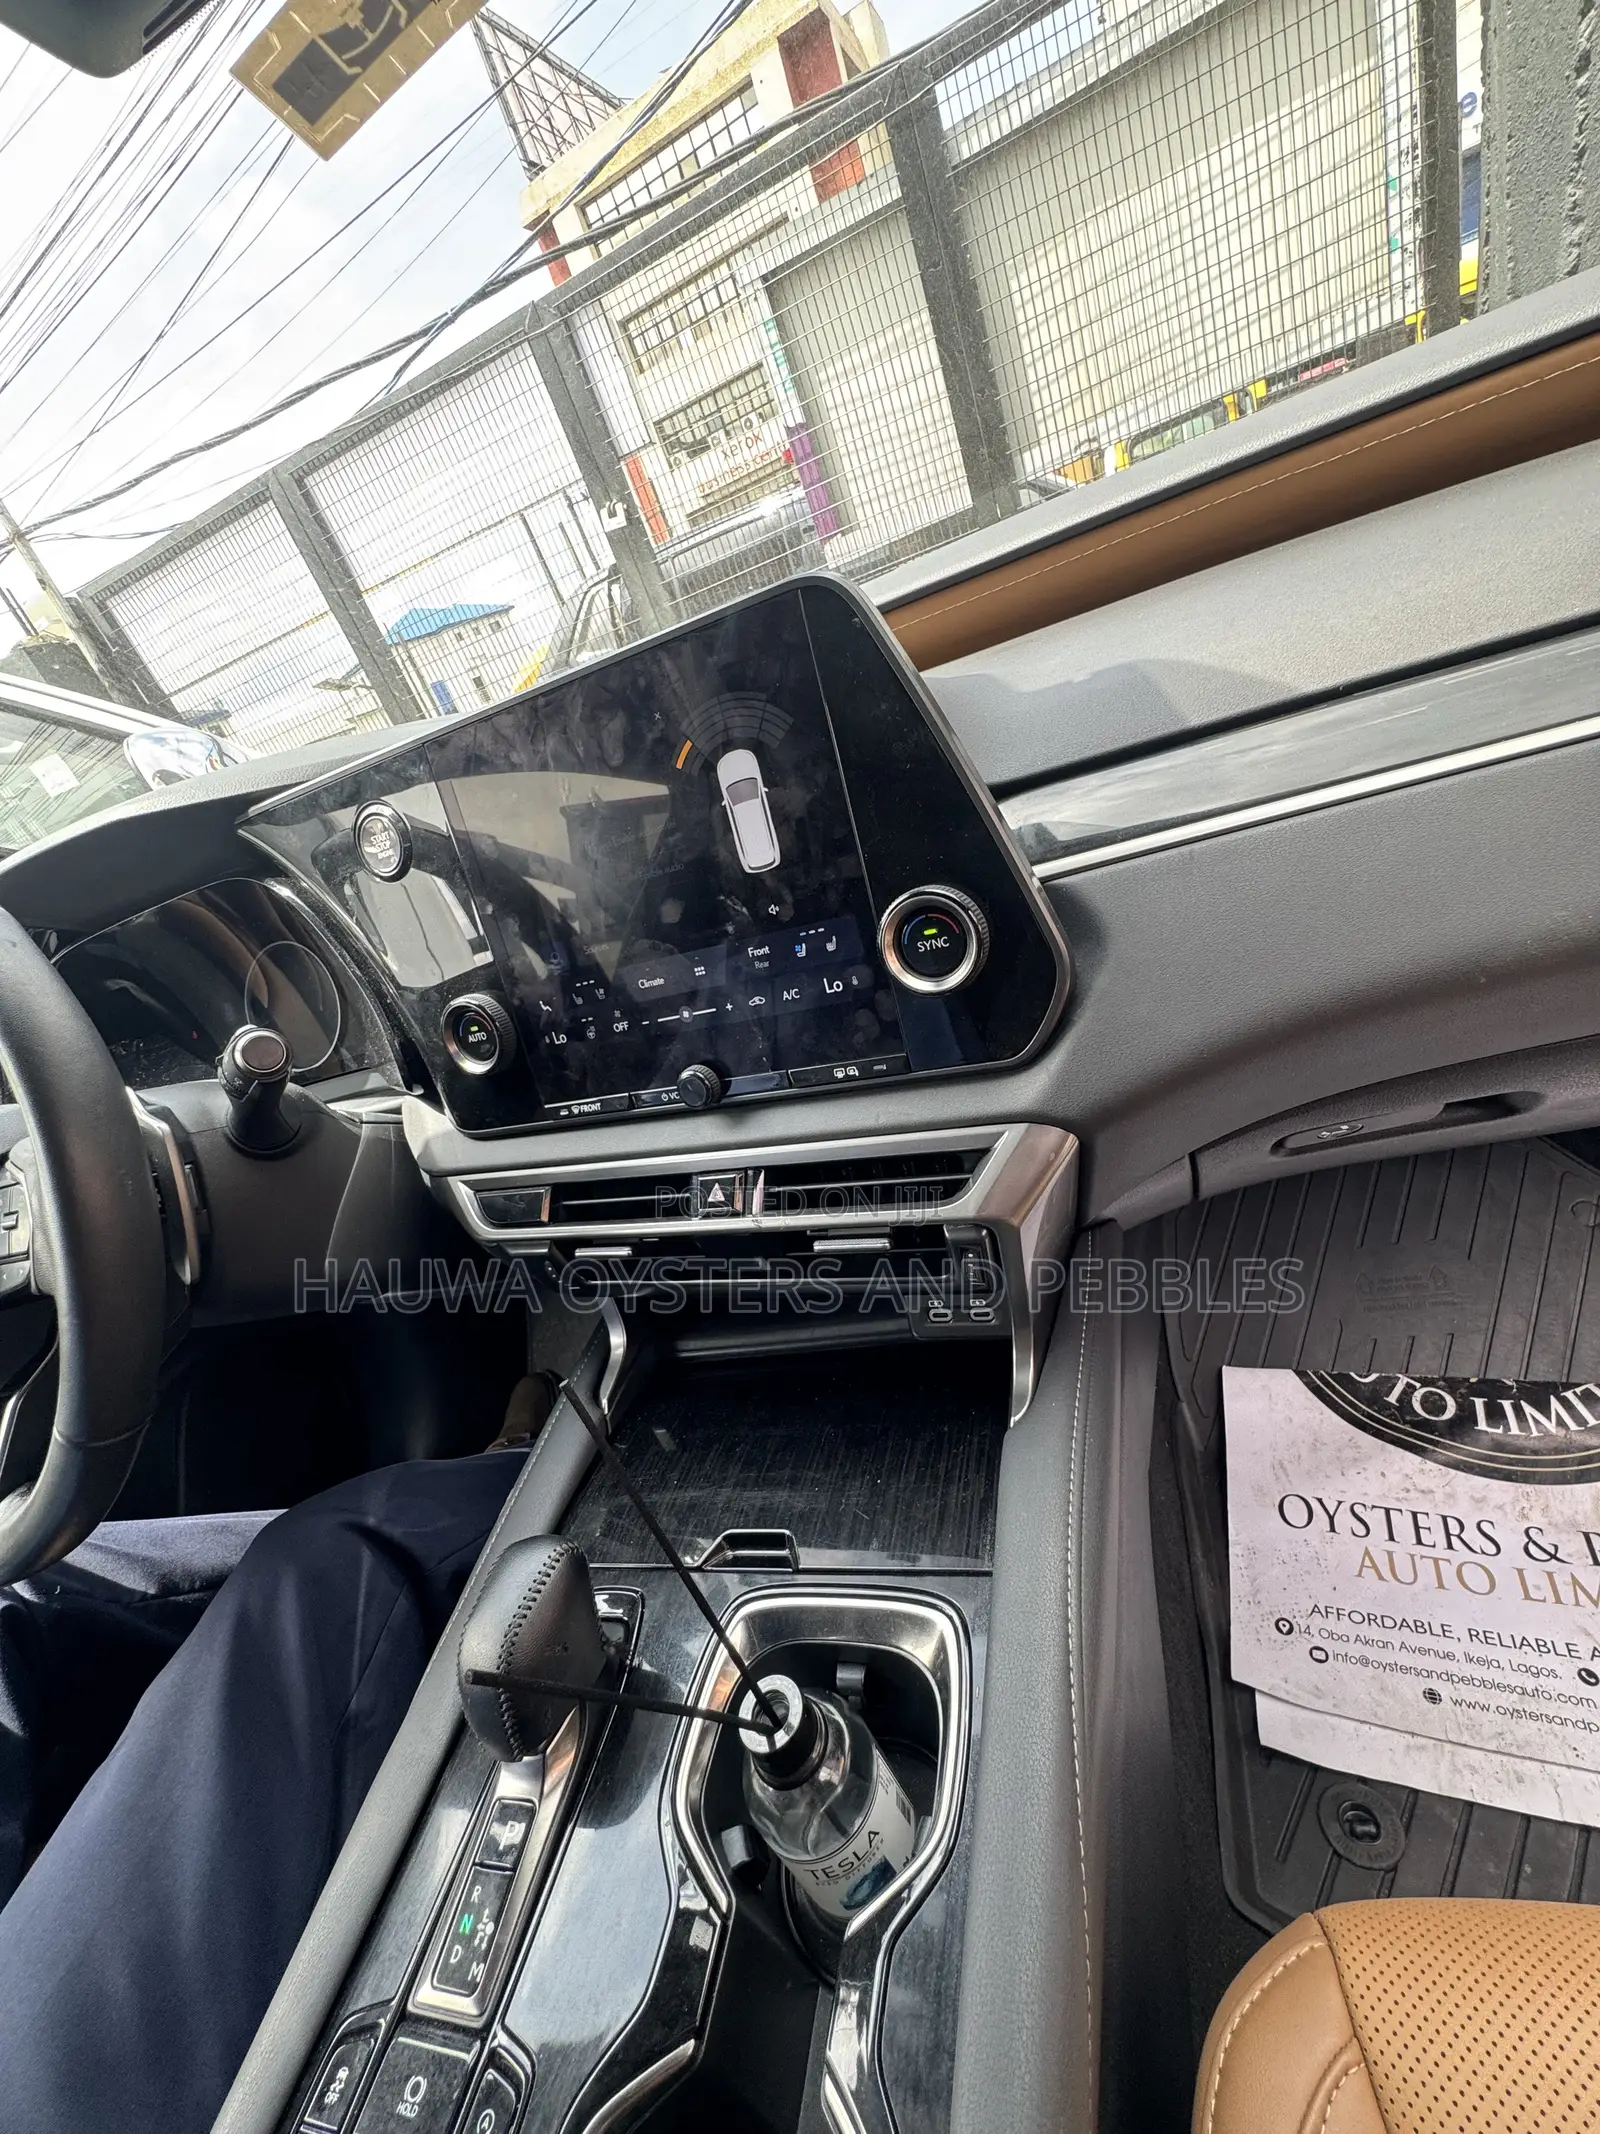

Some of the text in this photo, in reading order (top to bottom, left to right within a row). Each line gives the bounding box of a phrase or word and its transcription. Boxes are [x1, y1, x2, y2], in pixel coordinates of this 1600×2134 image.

[721, 430, 762, 462] xerox
[370, 831, 390, 845] START
[375, 840, 391, 852] STOP
[747, 944, 771, 958] Front
[916, 936, 950, 953] SYNC
[754, 959, 770, 970] Rear
[638, 976, 665, 989] Climate
[823, 977, 844, 995] Lo
[782, 988, 800, 1001] A/C
[613, 1021, 629, 1033] OFF
[468, 1031, 488, 1044] AUTO
[551, 1031, 568, 1045] Lo
[580, 1102, 602, 1114] FRONT
[1348, 1371, 1458, 1421] TO
[1277, 1493, 1502, 1557] OYSTERS
[1522, 1525, 1574, 1565] &
[1353, 1545, 1497, 1596] AUTO
[1308, 1603, 1461, 1643] AFFORDABLE,
[1467, 1627, 1583, 1660] RELIABLE
[1318, 1627, 1350, 1643] Oba
[1353, 1633, 1395, 1651] Akran
[1398, 1640, 1461, 1664] Avenue,
[1463, 1651, 1505, 1671] Ikeja,
[1508, 1658, 1562, 1680] Lagos.
[499, 1820, 520, 1850] P
[803, 1830, 880, 1880] TESLA
[471, 1885, 482, 1904] R
[459, 1913, 474, 1935] N
[449, 1944, 462, 1964] D
[467, 1961, 485, 1983] M
[323, 2091, 340, 2105] OFF
[395, 2101, 419, 2118] HOLD
